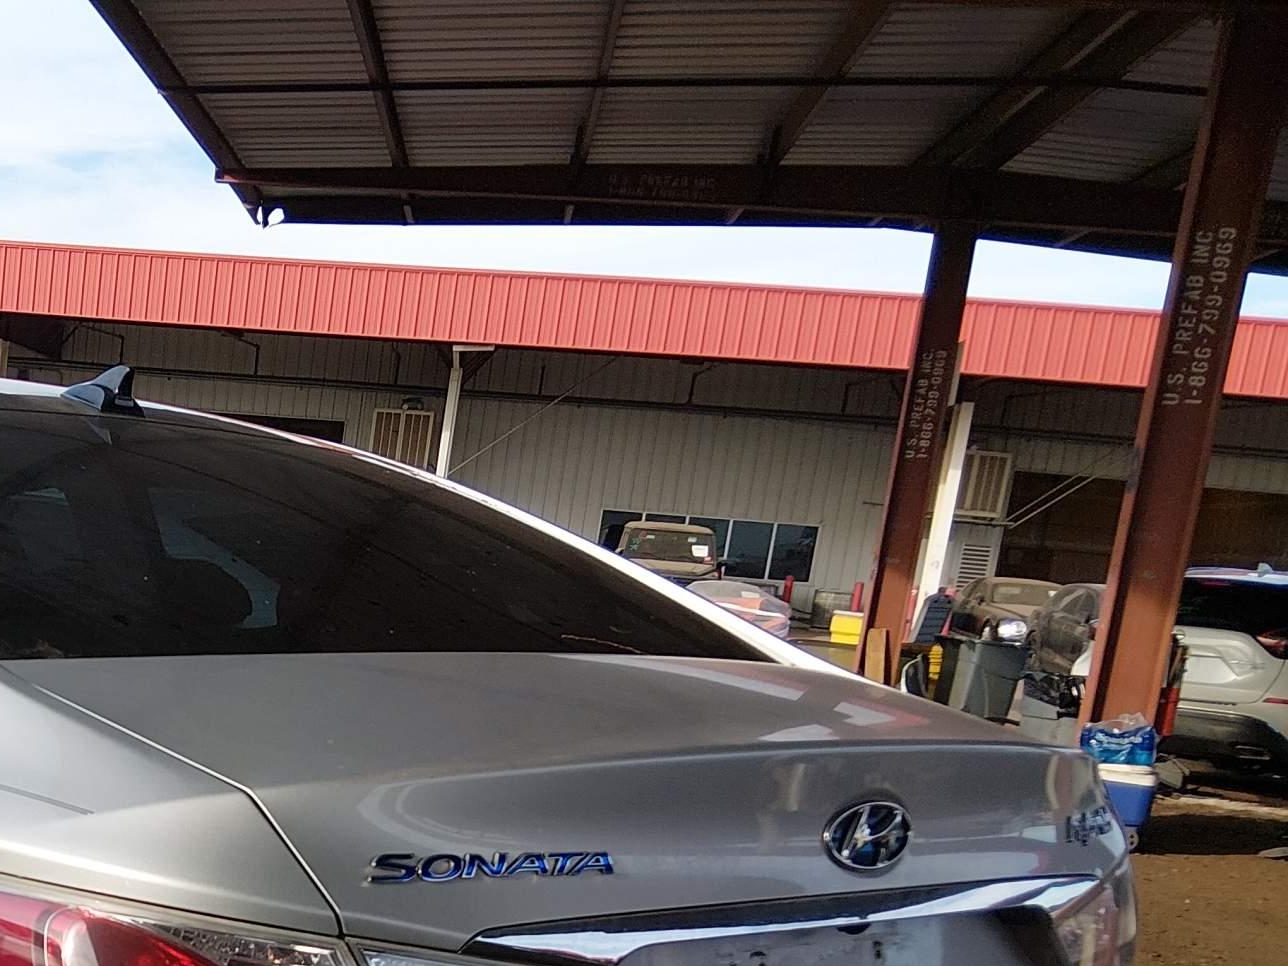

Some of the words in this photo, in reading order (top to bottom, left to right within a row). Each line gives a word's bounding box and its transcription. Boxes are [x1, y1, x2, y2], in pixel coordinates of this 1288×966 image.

[1172, 275, 1205, 355] PREFAB
[1184, 226, 1237, 406] 1-866-799-0969
[910, 379, 929, 429] PREFAB
[367, 851, 614, 883] SONATA
